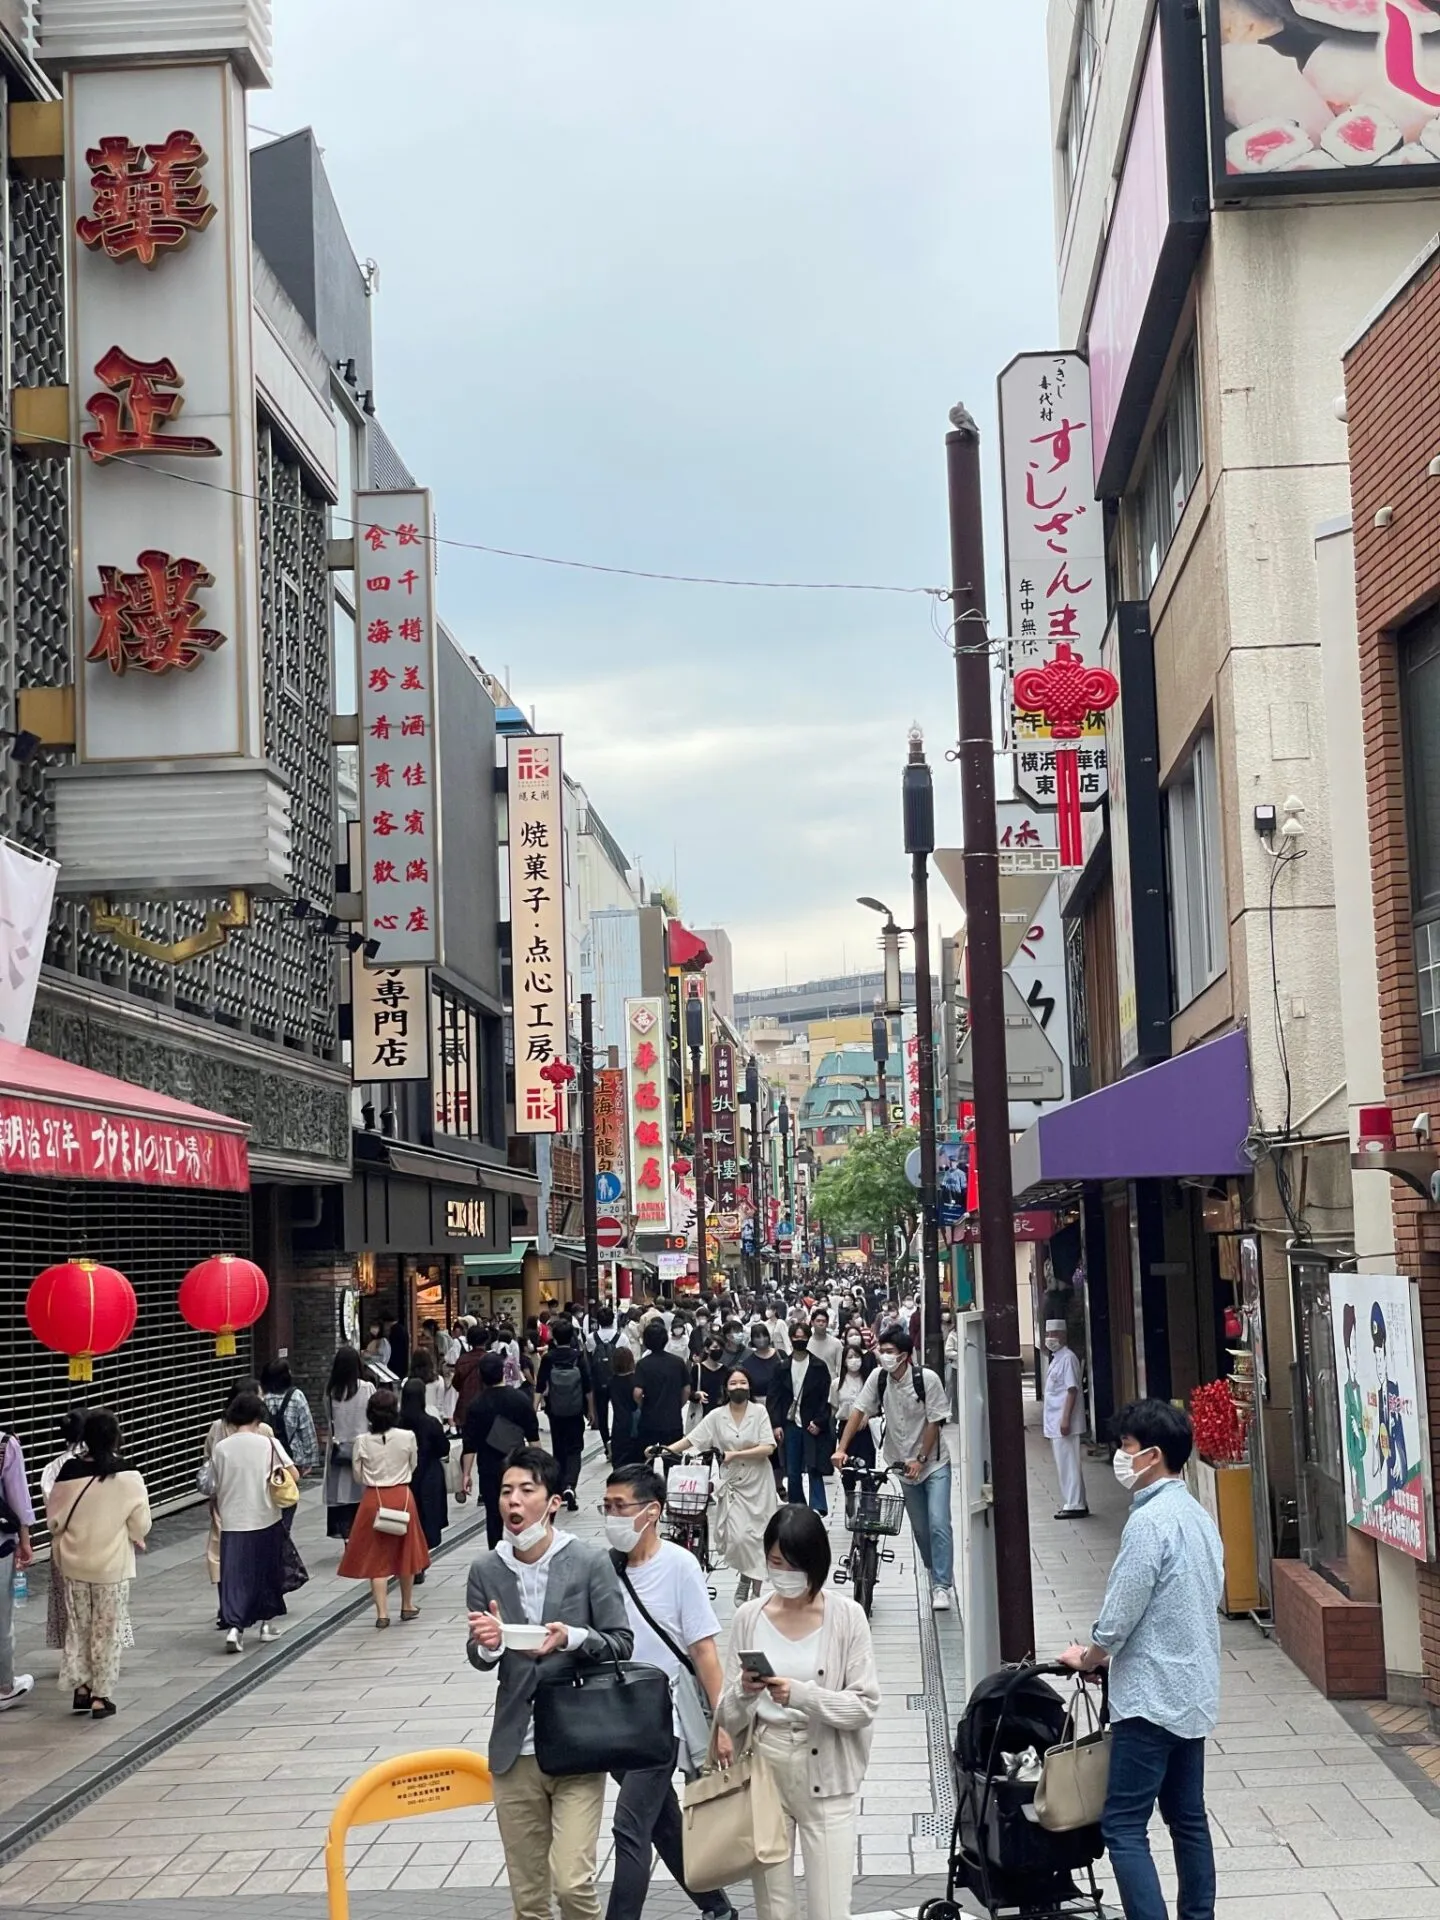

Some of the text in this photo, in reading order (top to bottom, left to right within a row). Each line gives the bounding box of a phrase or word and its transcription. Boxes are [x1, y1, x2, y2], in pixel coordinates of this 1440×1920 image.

[1052, 358, 1066, 399] つきじ
[1026, 418, 1092, 668] すしざんま
[1021, 749, 1107, 772] 横浜華街
[1036, 774, 1100, 795] 東店
[371, 969, 410, 1067] 専門店
